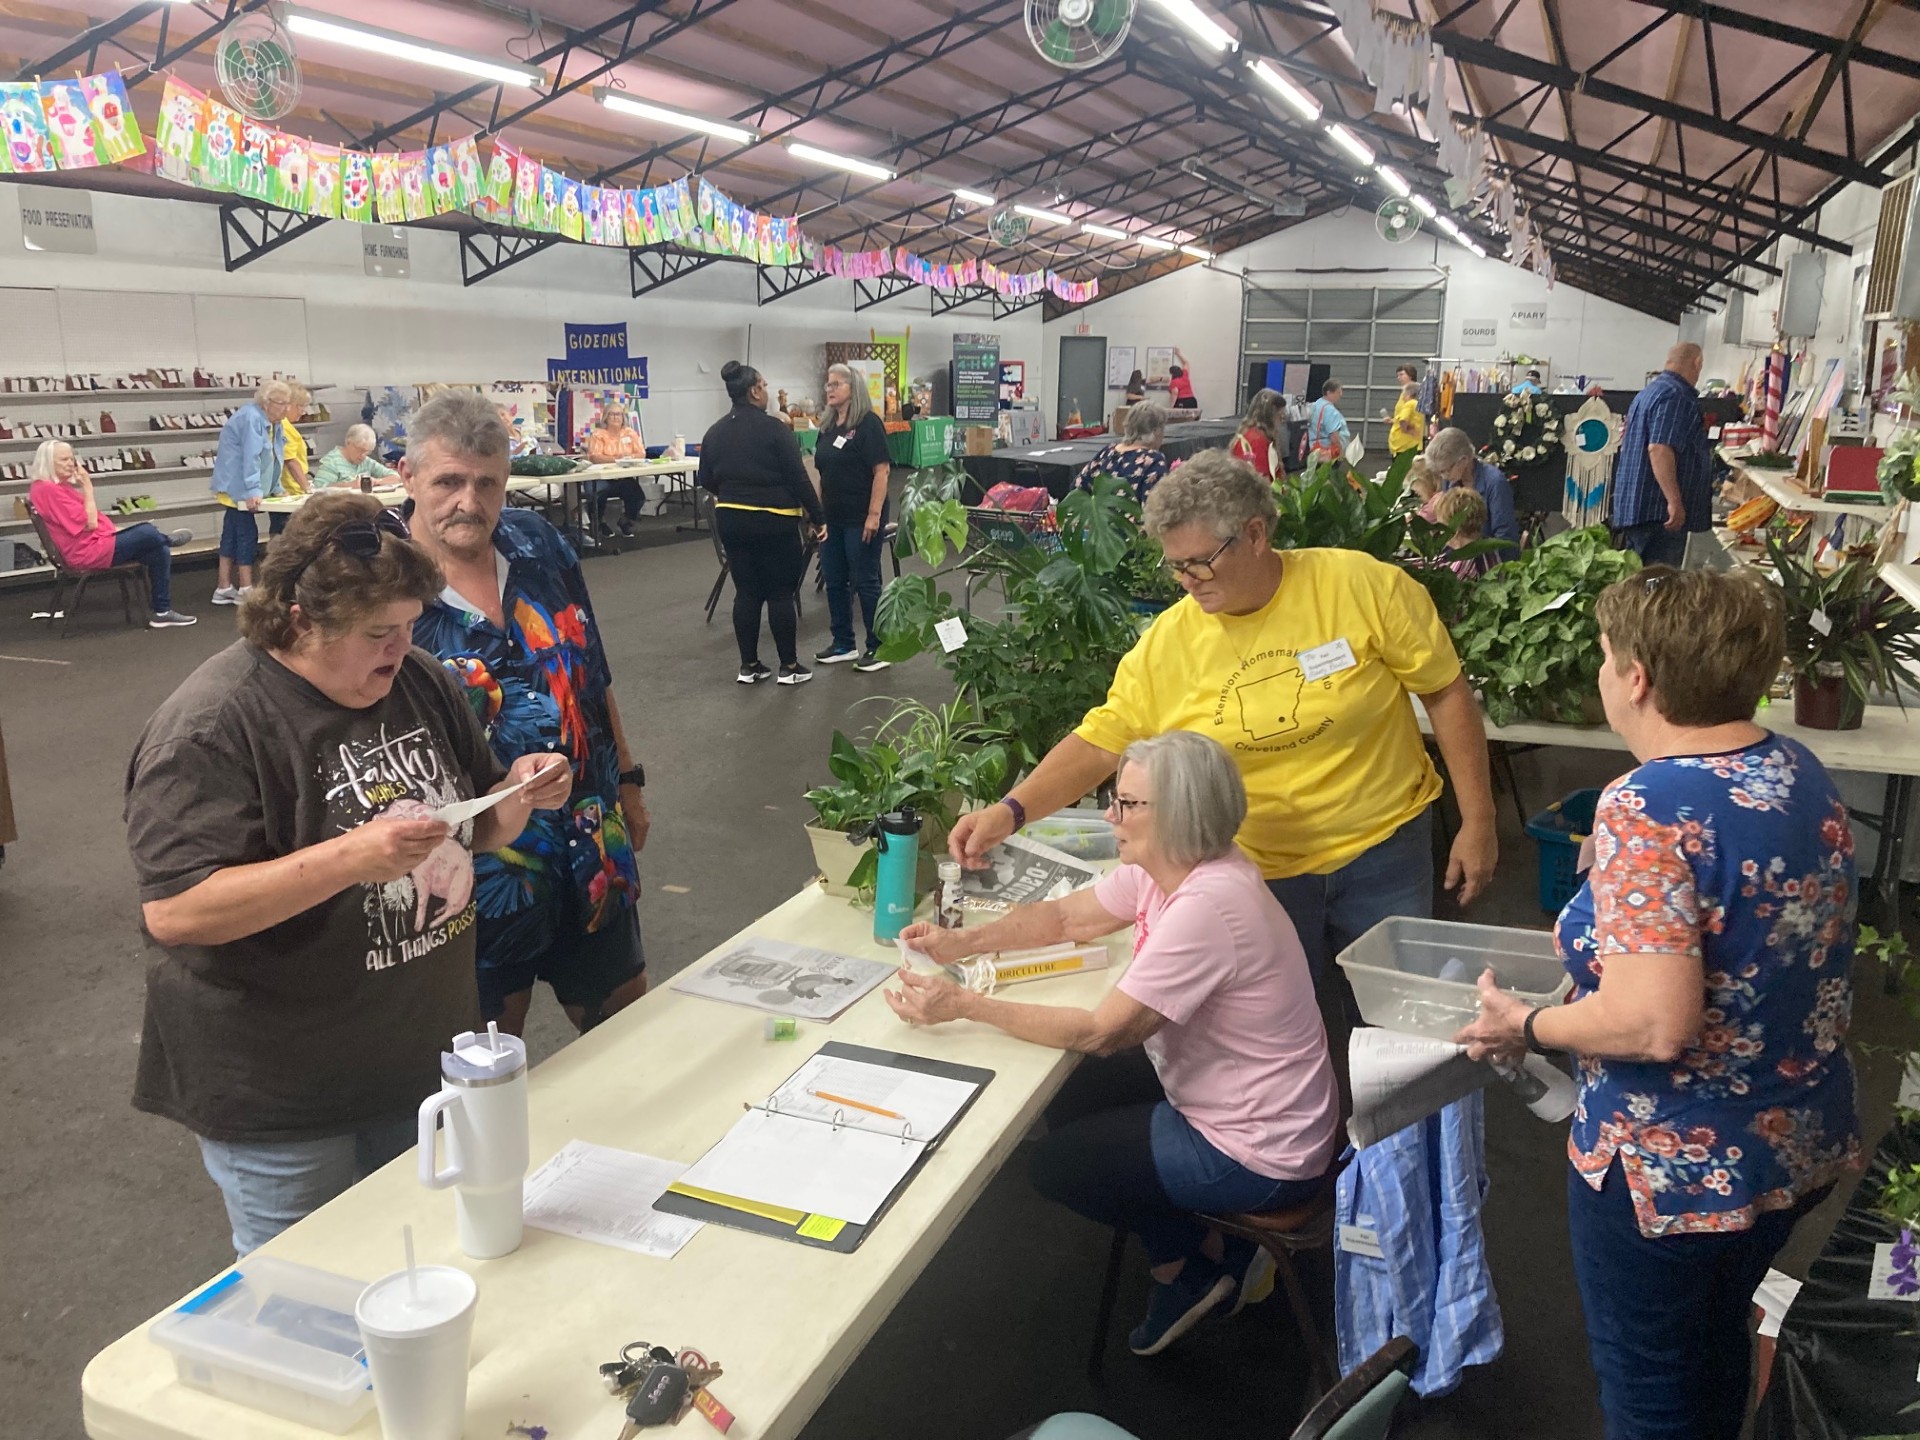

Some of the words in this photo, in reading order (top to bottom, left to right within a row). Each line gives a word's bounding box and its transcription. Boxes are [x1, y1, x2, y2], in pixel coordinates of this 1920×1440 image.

[22, 208, 42, 226] FOOD
[45, 211, 93, 230] PRESERVATION
[364, 243, 378, 257] HOME
[1511, 311, 1545, 319] APIARY
[569, 332, 625, 349] GIDEONS
[1463, 328, 1496, 336] GOURDS
[551, 365, 645, 384] INTERNATIONAL
[1235, 741, 1297, 753] Cleveland
[1299, 716, 1334, 745] County
[364, 781, 407, 806] MAKES
[1002, 866, 1049, 903] RODEO
[365, 947, 397, 971] ALL
[398, 928, 448, 963] THINGS
[998, 962, 1057, 979] ORICULTURE
[647, 1375, 670, 1405] Jeep
